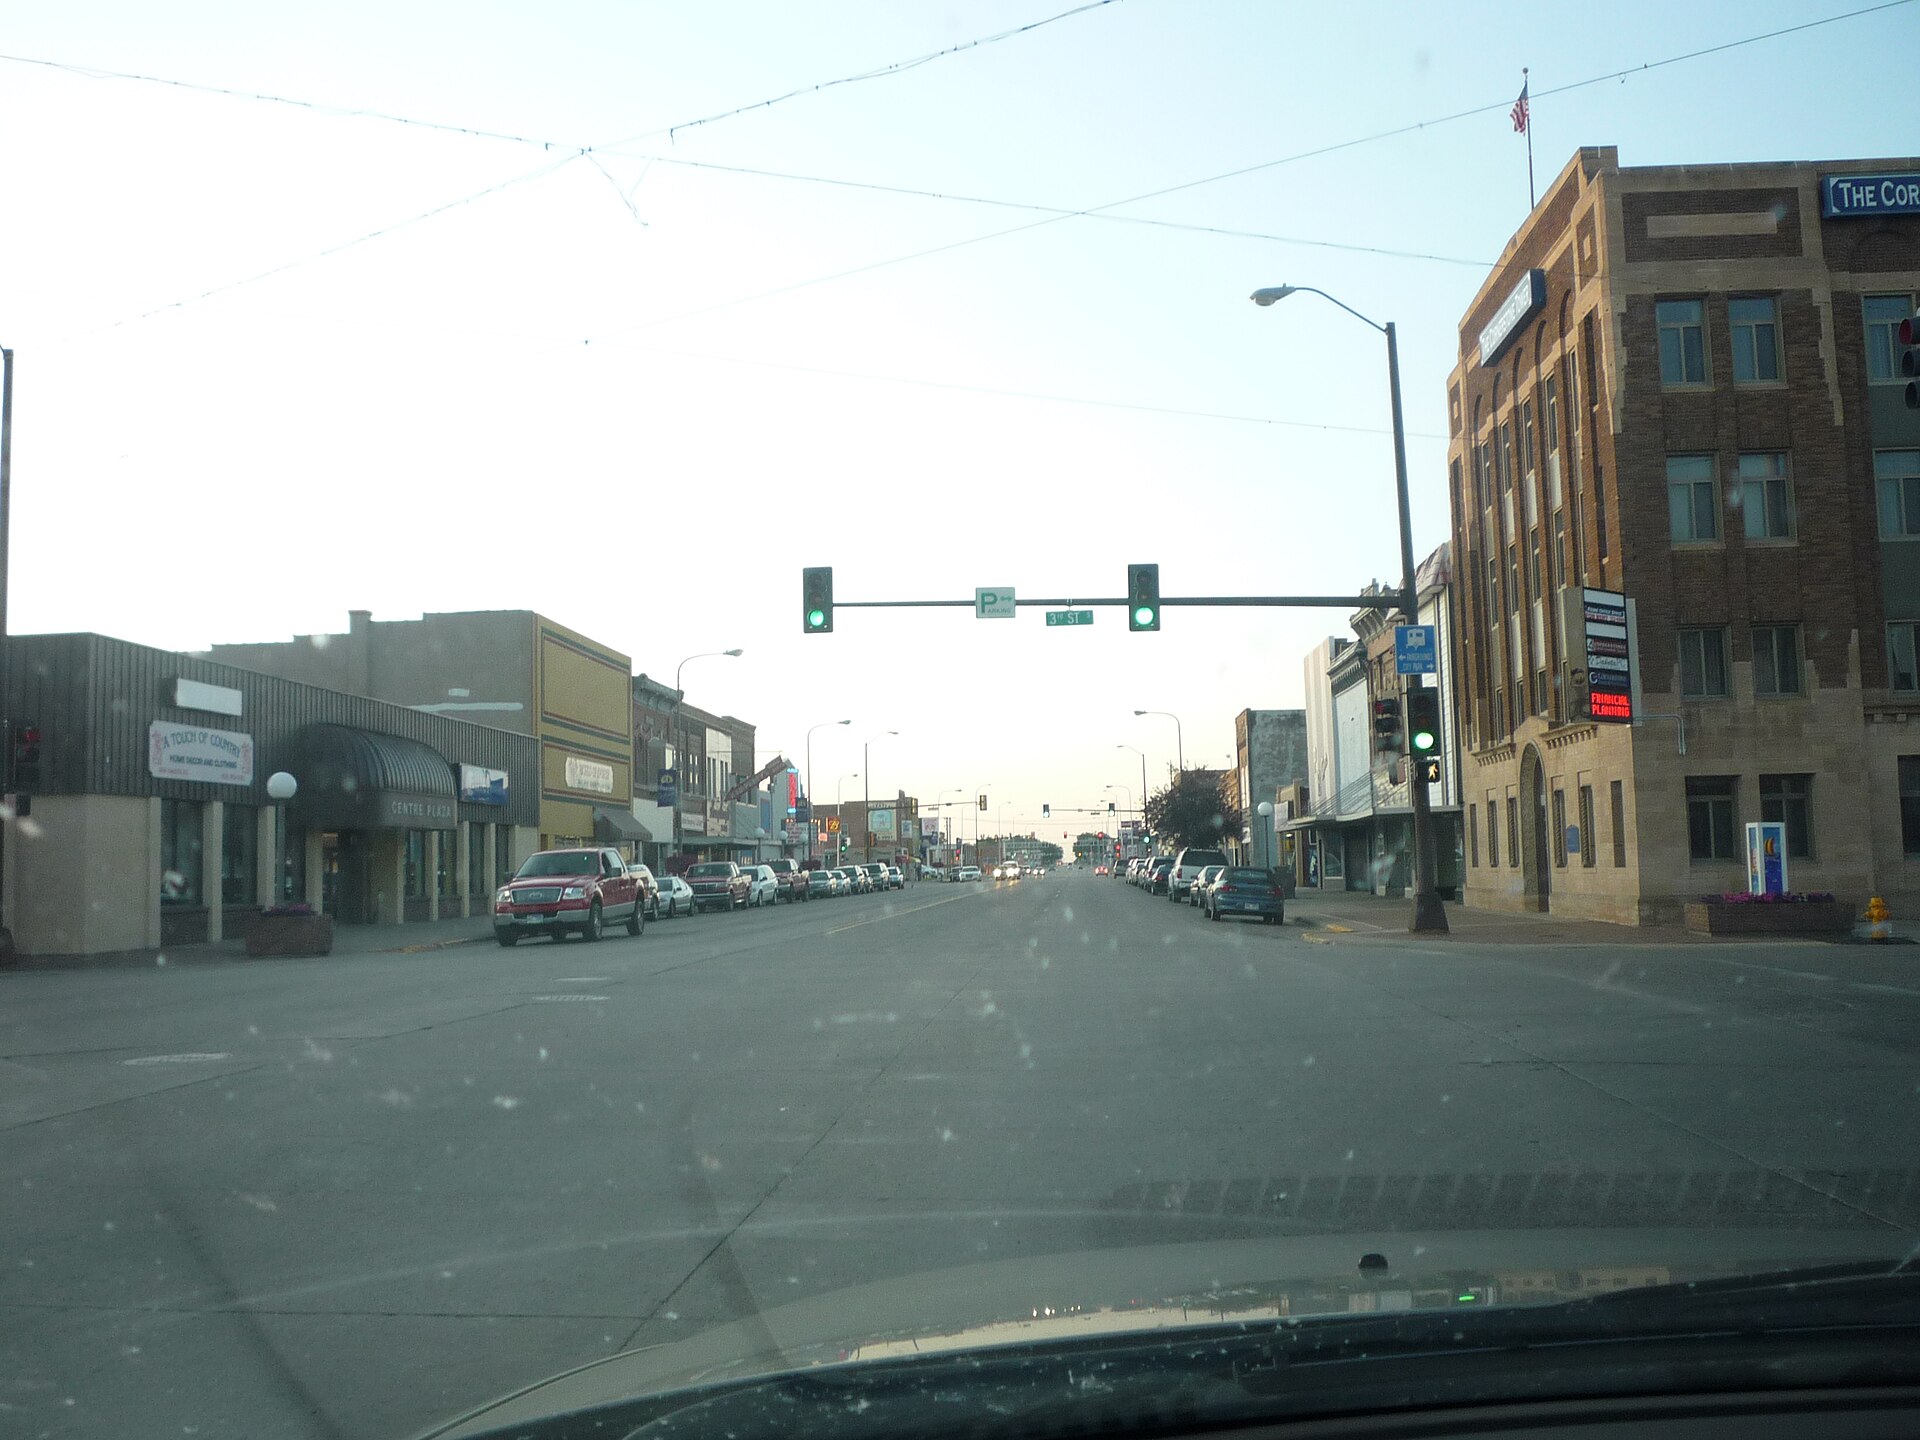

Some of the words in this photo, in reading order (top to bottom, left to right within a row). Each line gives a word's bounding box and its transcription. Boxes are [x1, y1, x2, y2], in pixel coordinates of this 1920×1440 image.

[1838, 181, 1877, 208] THE
[1067, 612, 1080, 624] ST
[163, 735, 170, 749] A
[171, 731, 197, 745] TOUCH
[198, 731, 208, 744] OF
[210, 734, 241, 758] COUNTRY
[391, 801, 423, 816] CENTRE
[427, 804, 451, 817] PLAZA
